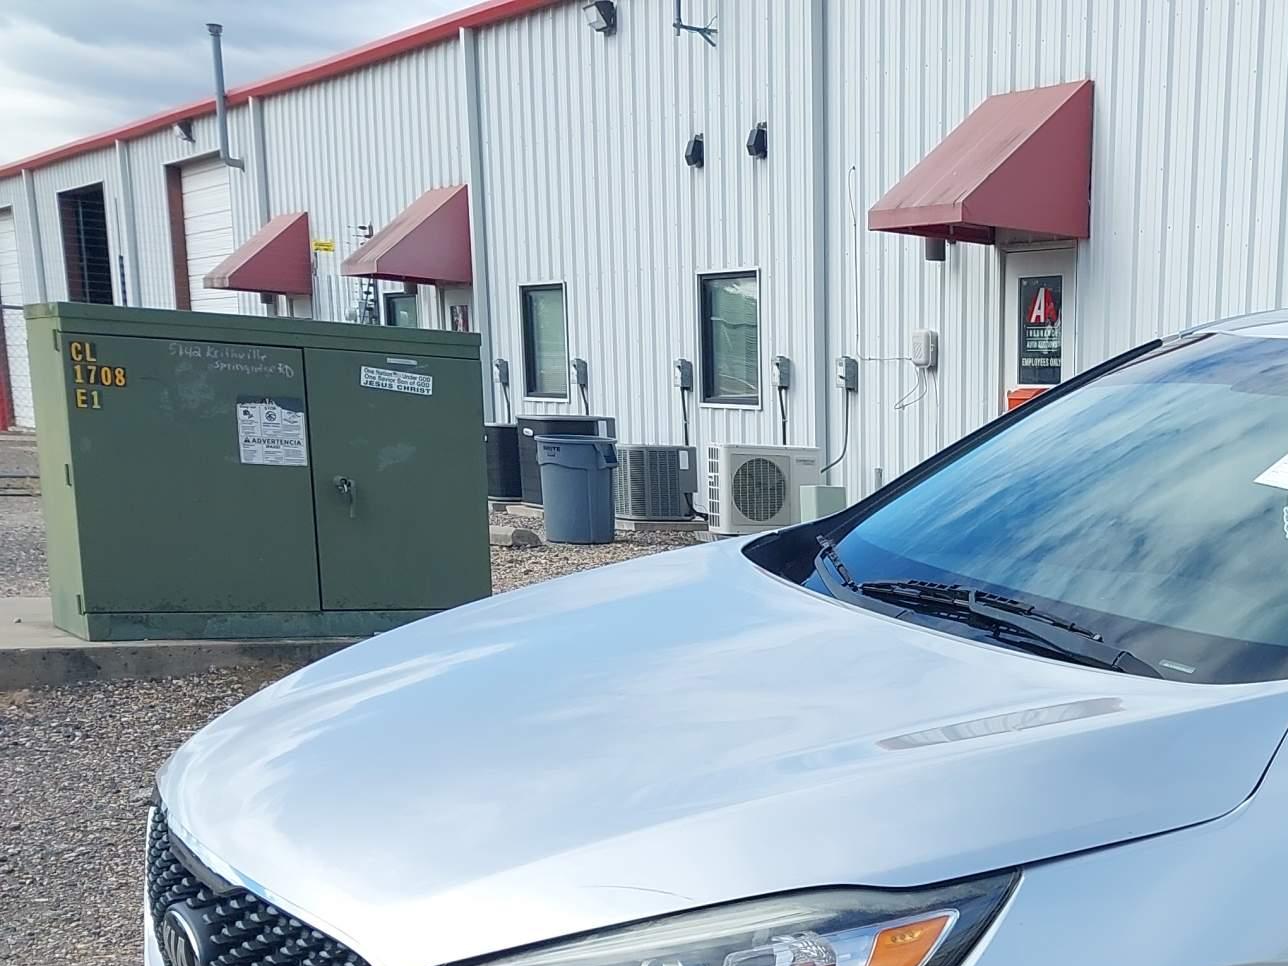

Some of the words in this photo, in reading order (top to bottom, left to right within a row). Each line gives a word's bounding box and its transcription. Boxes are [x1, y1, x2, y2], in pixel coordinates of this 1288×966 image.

[70, 341, 97, 362] CL
[74, 364, 126, 387] 1708
[363, 380, 394, 389] JESUS
[396, 384, 432, 394] CHRIST
[416, 381, 430, 389] GOD
[76, 388, 101, 409] E1
[251, 437, 302, 446] ADVERTENCIA
